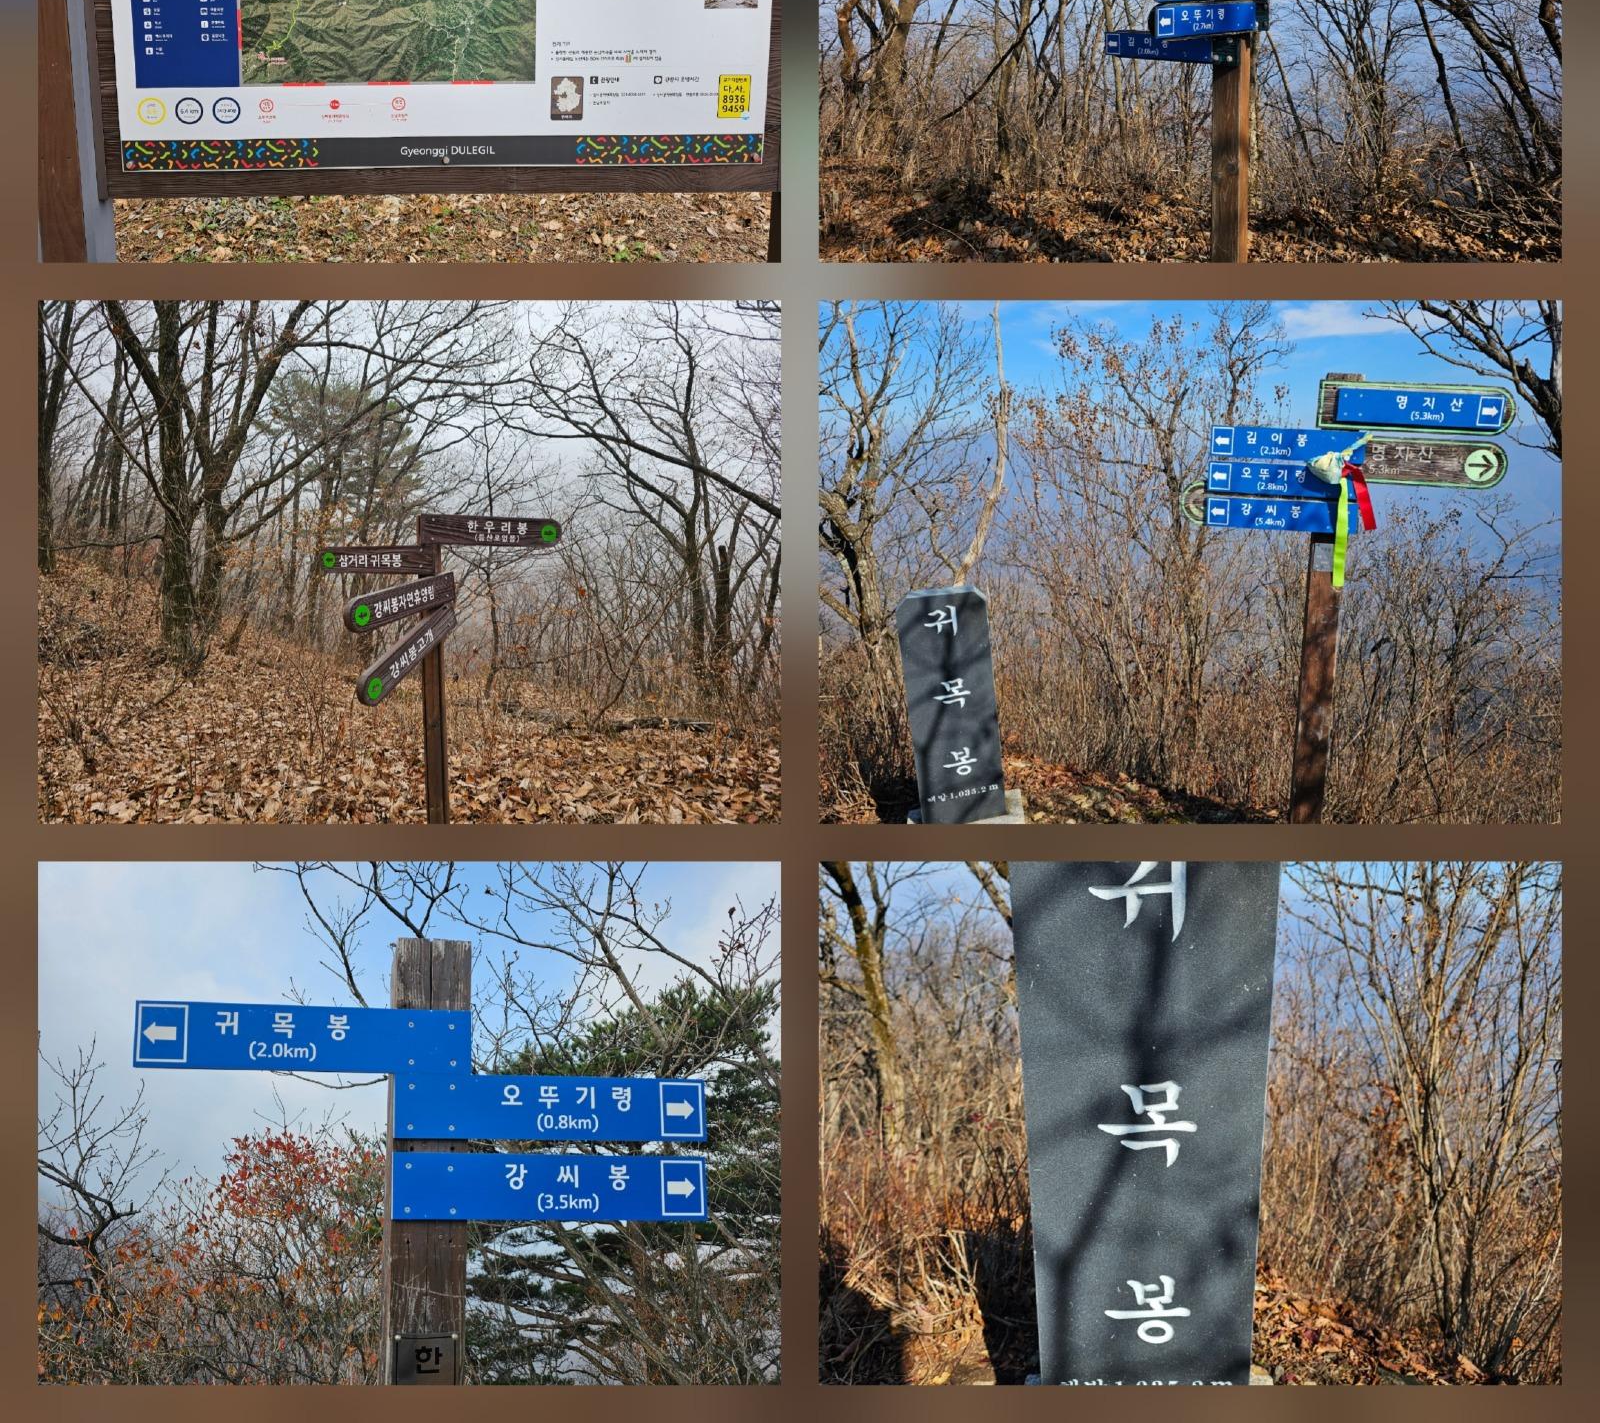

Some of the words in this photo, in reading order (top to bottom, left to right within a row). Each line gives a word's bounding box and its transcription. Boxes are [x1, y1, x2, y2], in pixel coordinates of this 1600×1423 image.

[723, 95, 745, 104] 8936
[722, 105, 745, 113] 9459
[400, 146, 448, 157] Gyeonggi
[451, 146, 495, 155] DULEGIL
[1410, 411, 1444, 422] (5.3km)
[1260, 446, 1291, 457] (2.1km)
[1257, 482, 1287, 492] (2.8km)
[466, 520, 528, 535] 한우리봉
[370, 554, 402, 567] 귀목봉
[373, 585, 435, 618] 강씨봉자연휴양림
[248, 1040, 317, 1062] (2.0km)
[537, 1114, 599, 1133] (0.8km)
[537, 1192, 600, 1213] (3.5km)
[414, 1345, 444, 1376] 한
